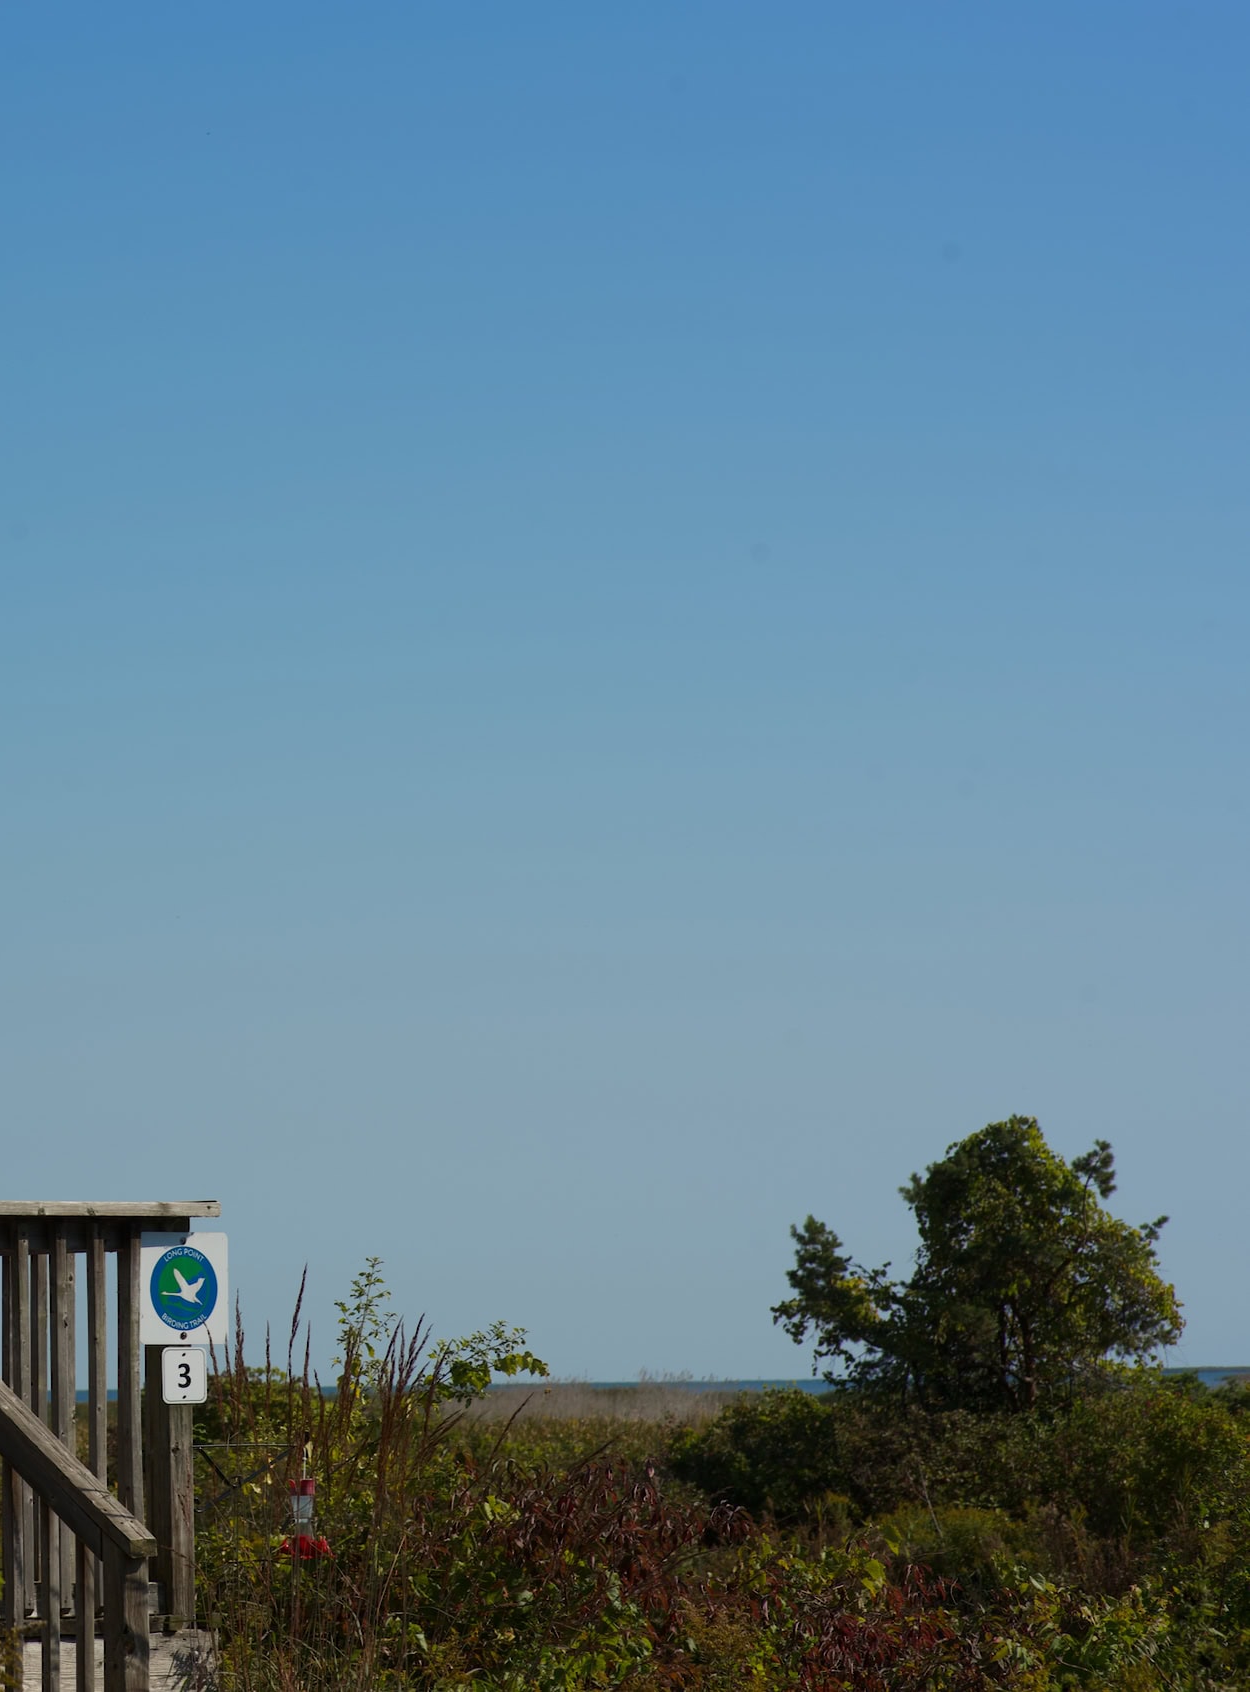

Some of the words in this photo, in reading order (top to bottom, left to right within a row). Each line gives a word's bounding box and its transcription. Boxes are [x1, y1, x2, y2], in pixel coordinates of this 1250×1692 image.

[163, 1249, 183, 1262] LONG
[184, 1248, 204, 1262] POINT
[161, 1313, 189, 1329] BIRDING
[190, 1314, 207, 1328] TRAIL
[178, 1363, 191, 1388] 3
